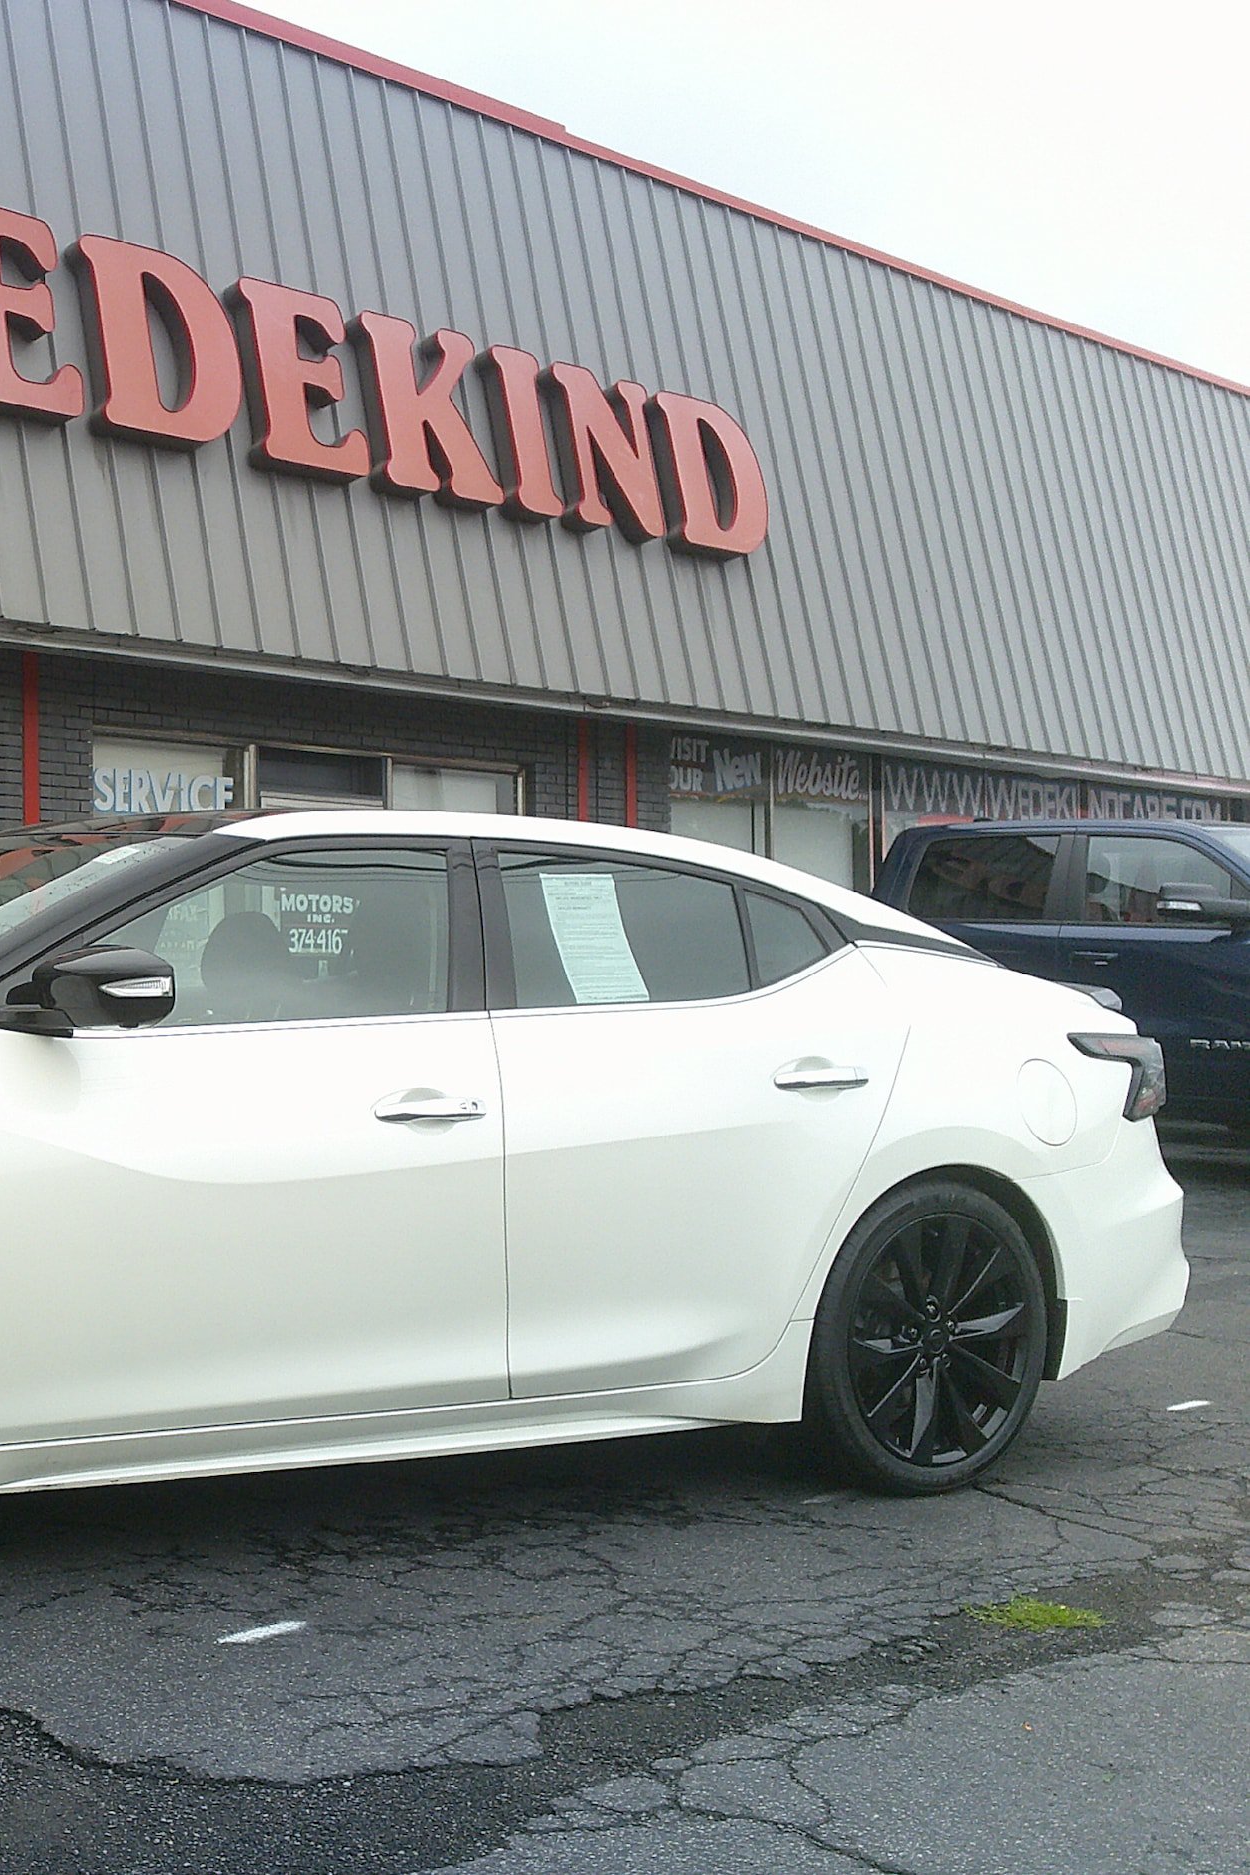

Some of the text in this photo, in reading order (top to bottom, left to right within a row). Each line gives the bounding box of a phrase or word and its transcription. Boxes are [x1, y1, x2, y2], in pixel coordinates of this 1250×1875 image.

[94, 767, 234, 813] SERVICE
[281, 893, 354, 914] MOTORS
[306, 913, 335, 923] INC.
